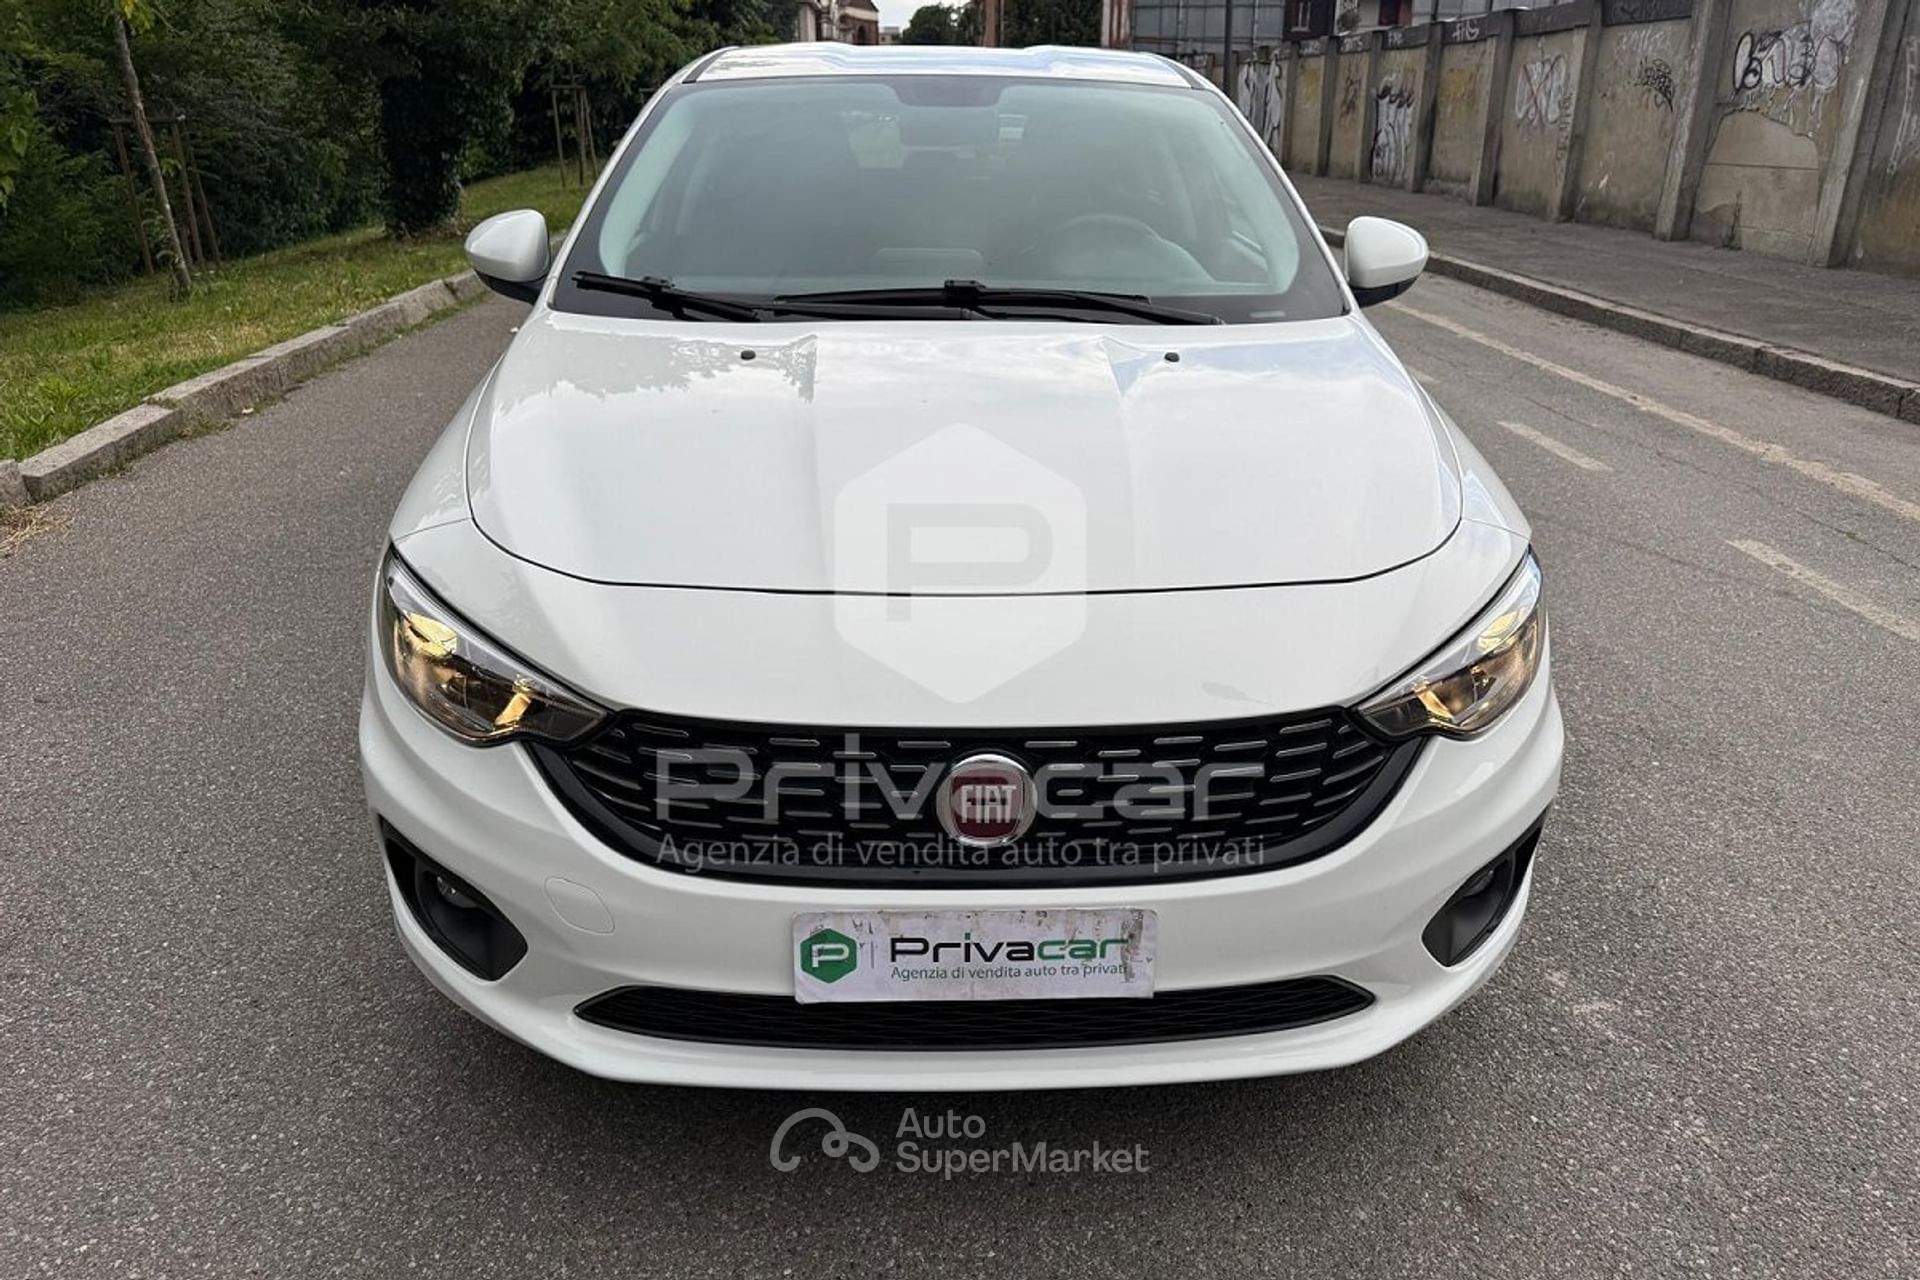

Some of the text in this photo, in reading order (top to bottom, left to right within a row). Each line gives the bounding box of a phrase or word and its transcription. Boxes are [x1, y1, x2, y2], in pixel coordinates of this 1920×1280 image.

[960, 784, 1018, 824] FIAT
[811, 943, 850, 968] P
[890, 932, 1130, 963] Privacar
[891, 966, 948, 982] Agenzia
[951, 965, 965, 980] di
[967, 964, 1021, 980] vendita
[1025, 964, 1057, 978] auto
[1061, 963, 1080, 976] tra
